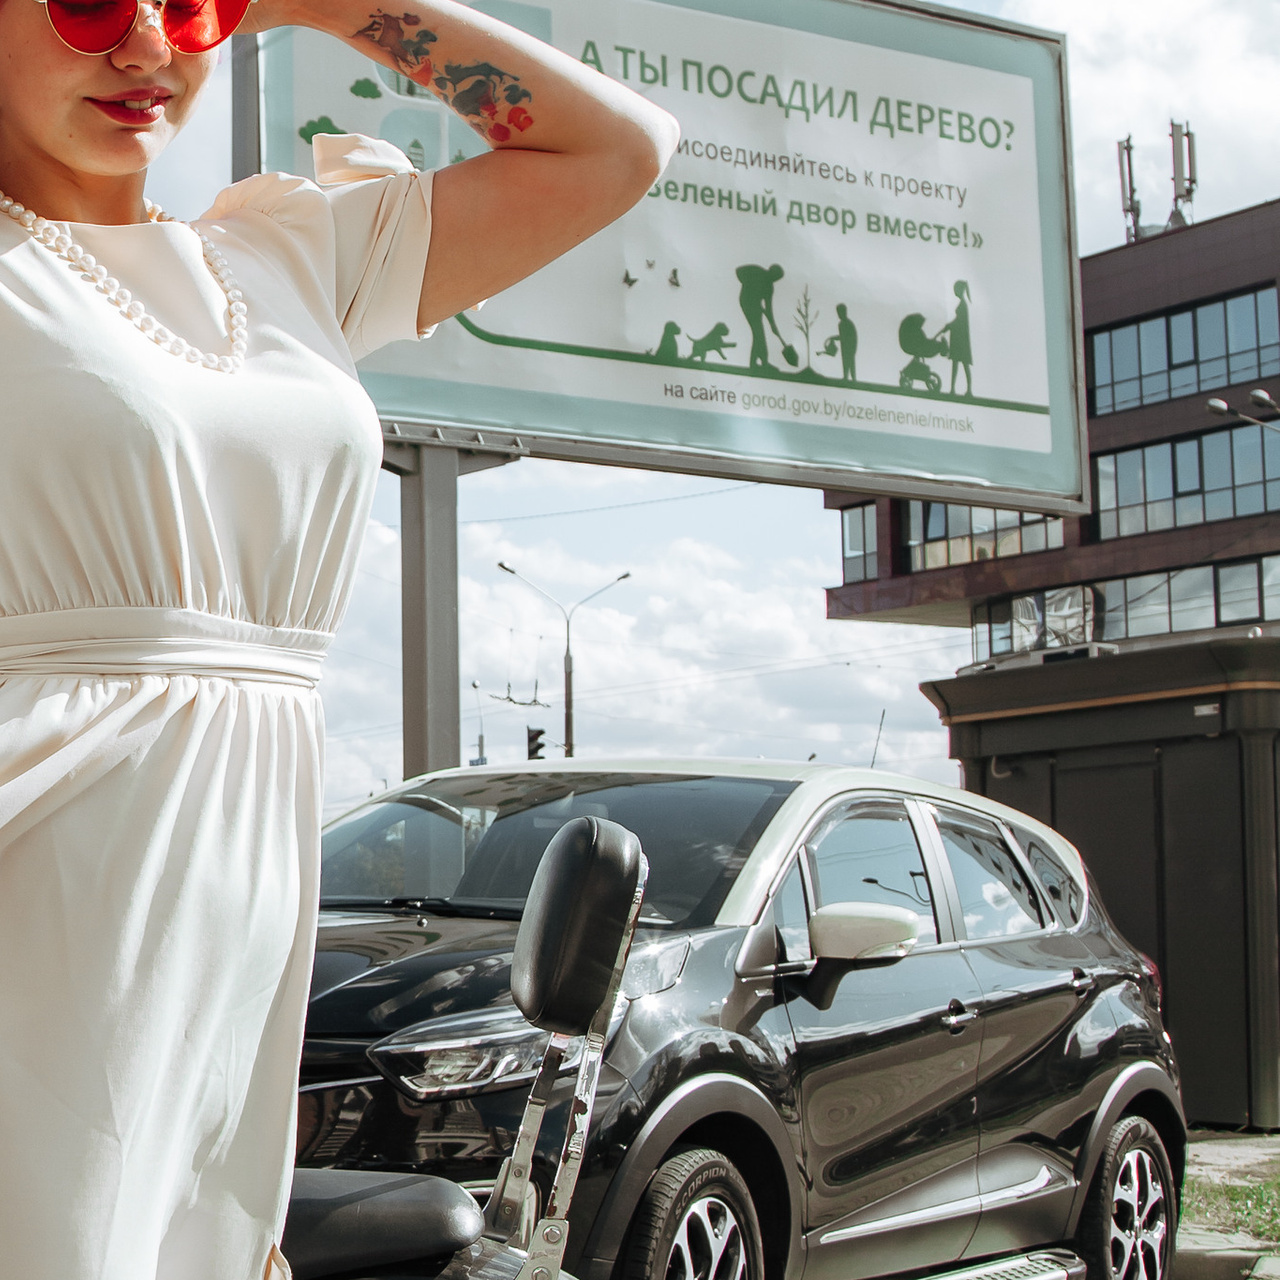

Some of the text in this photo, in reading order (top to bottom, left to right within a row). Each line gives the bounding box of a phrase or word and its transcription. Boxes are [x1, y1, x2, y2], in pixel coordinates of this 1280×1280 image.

[580, 40, 1015, 151] А ТЫ ПОСАДИЛ ДЕРЕВО?
[677, 138, 967, 208] исоединяйтесь к проекту
[787, 200, 856, 234] двор
[867, 213, 984, 249] вместе!»
[664, 383, 975, 433] на сайте gorod.gov.by/ozelenenie/minsk
[675, 1167, 726, 1220] SCORPION
